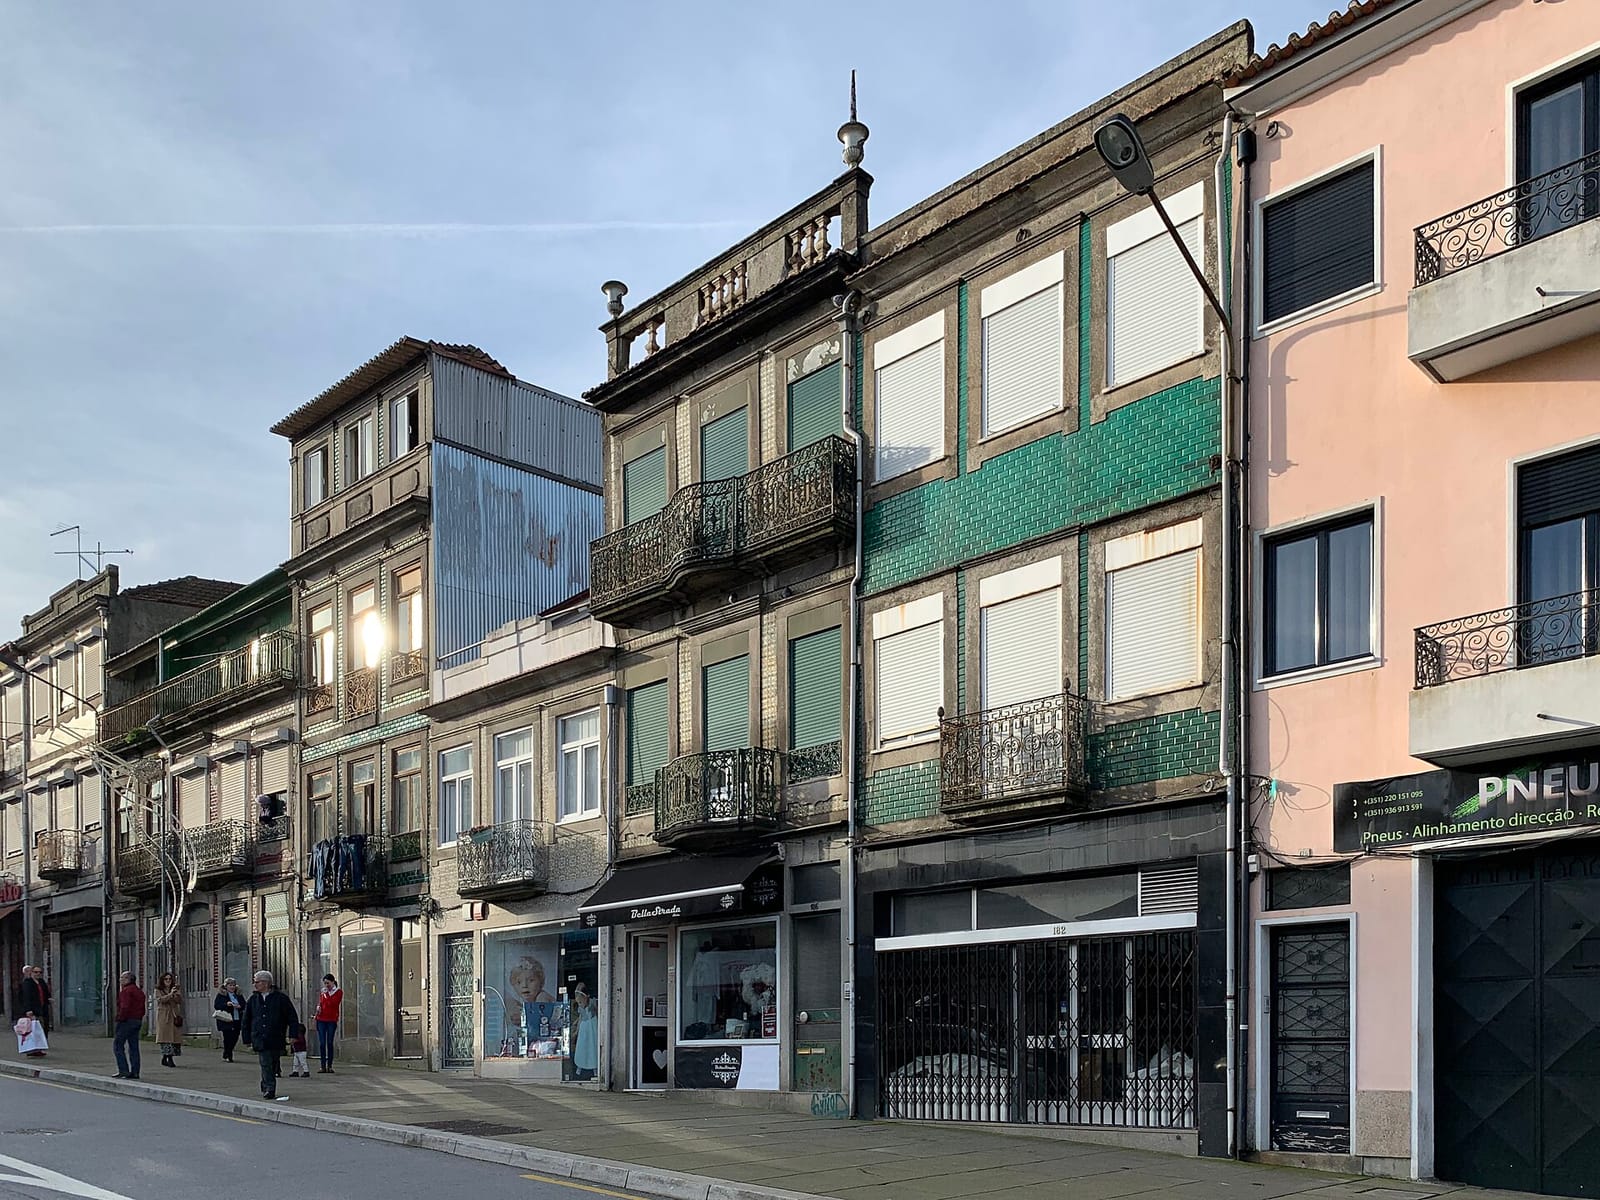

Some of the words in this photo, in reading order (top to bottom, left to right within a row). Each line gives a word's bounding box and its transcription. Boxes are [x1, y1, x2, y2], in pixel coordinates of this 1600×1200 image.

[1479, 762, 1599, 808] PNEU
[1384, 794, 1397, 802] 220
[1398, 792, 1409, 800] 151
[1410, 790, 1423, 798] 095
[1384, 806, 1397, 814] 936
[1397, 804, 1410, 812] 913
[1363, 830, 1402, 844] Pneus
[1412, 817, 1505, 838] Alinhamento
[1508, 807, 1574, 826] direcção
[1053, 926, 1066, 935] 182
